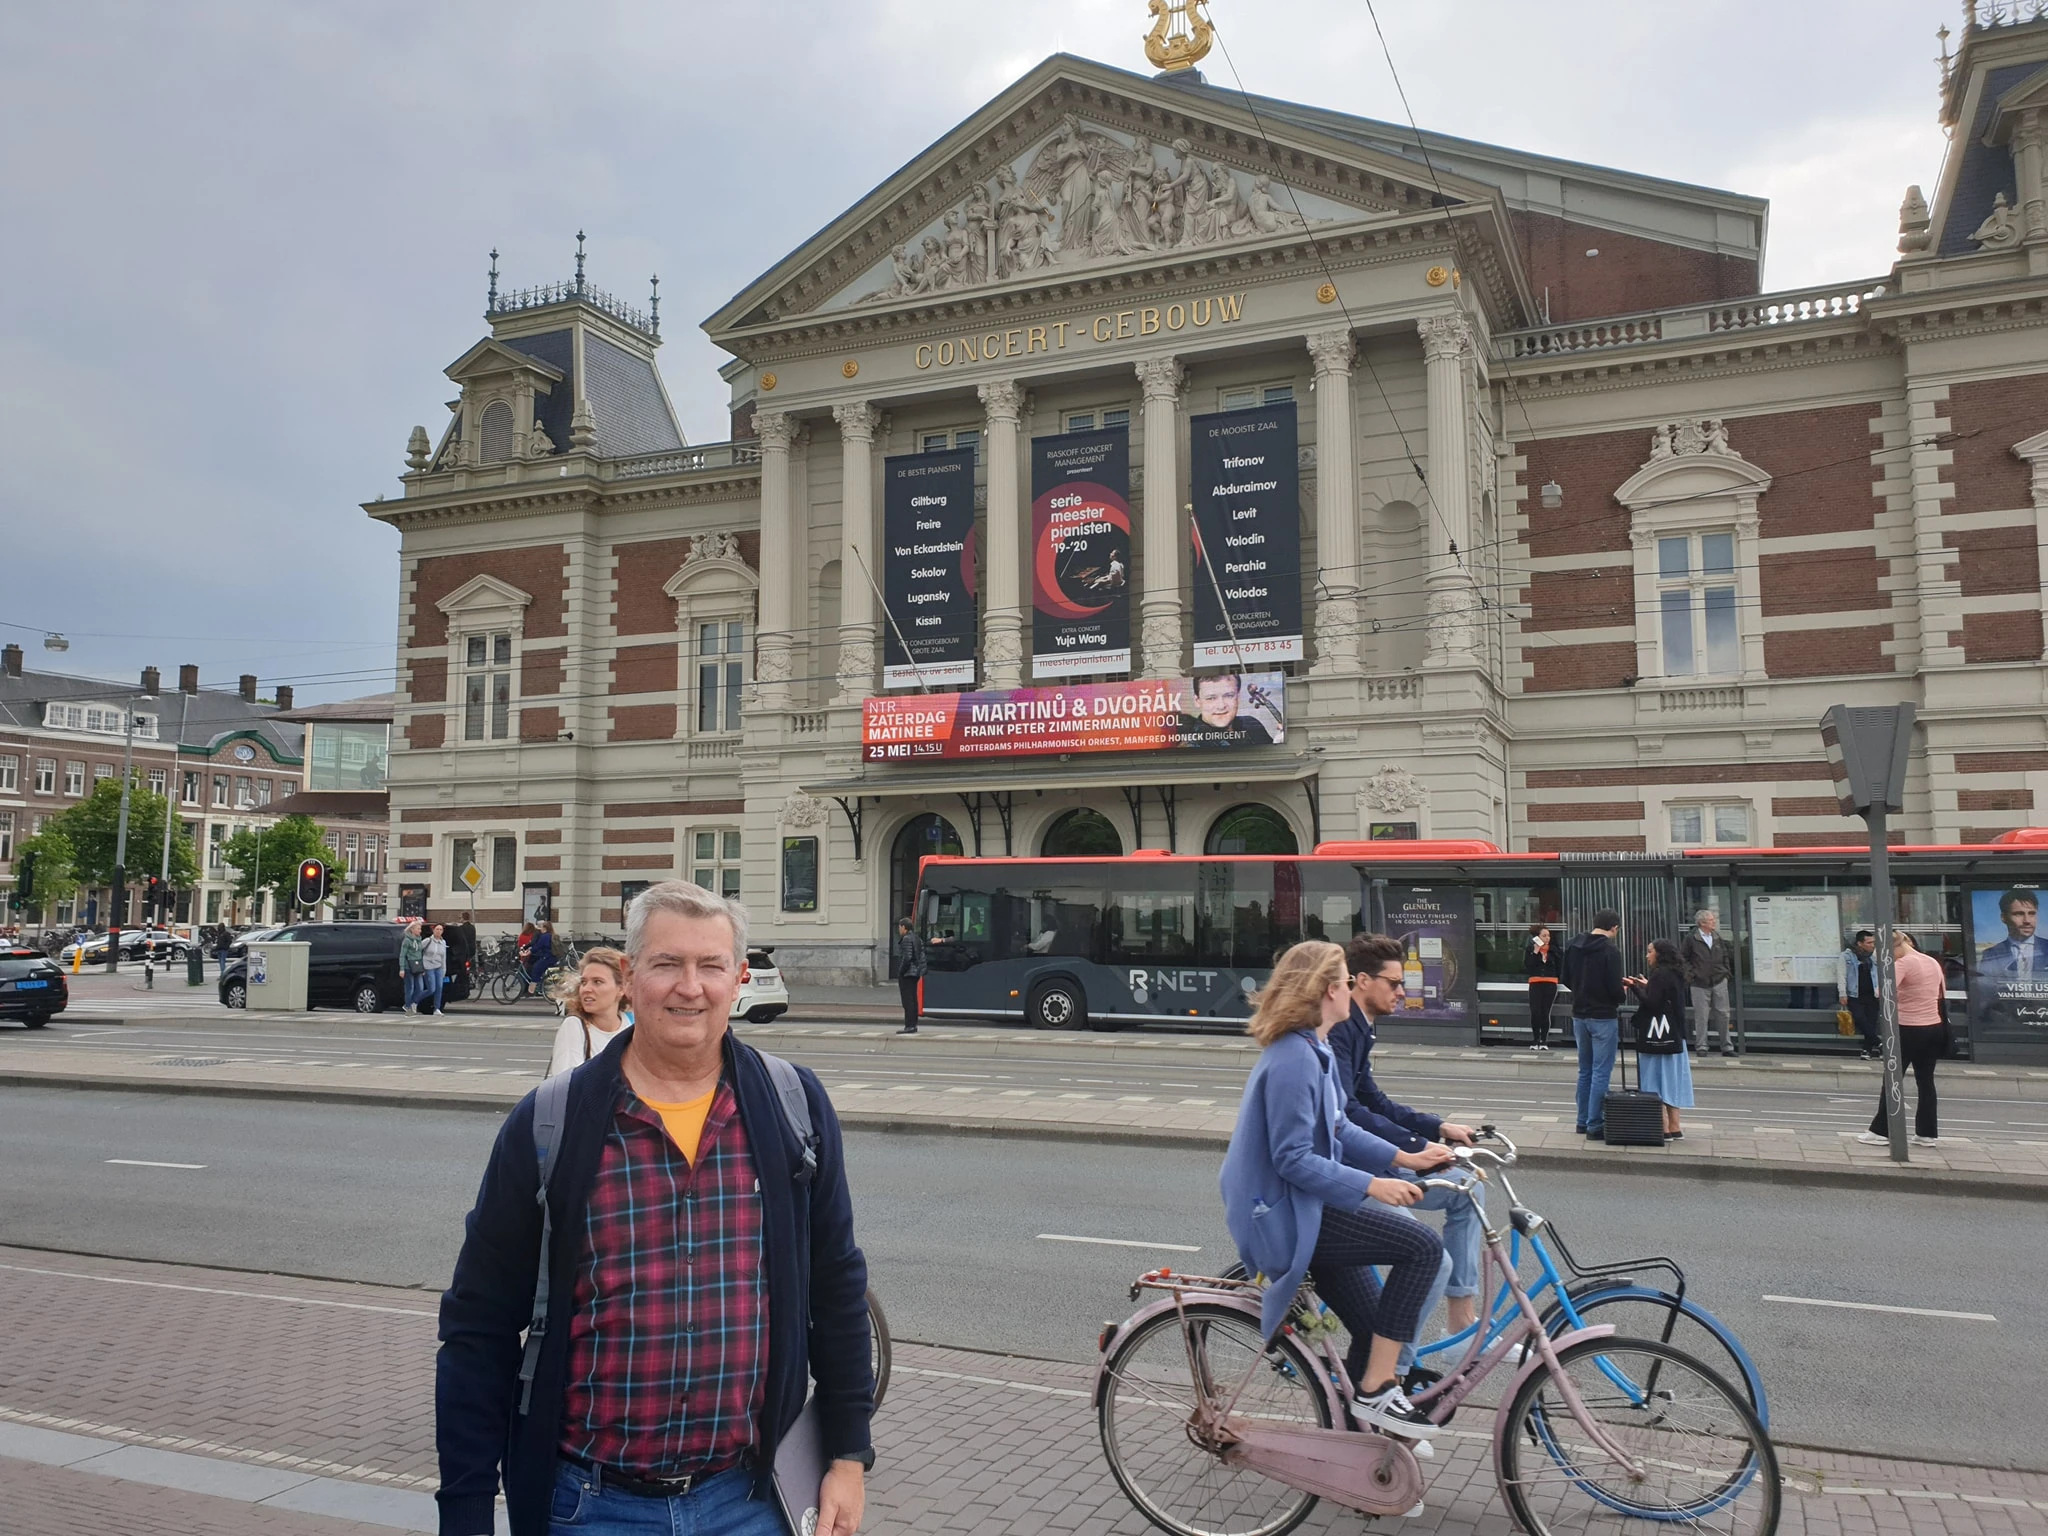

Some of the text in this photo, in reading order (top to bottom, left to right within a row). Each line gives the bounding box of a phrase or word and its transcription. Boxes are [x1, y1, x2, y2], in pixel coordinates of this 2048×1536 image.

[915, 292, 1247, 369] CONCERT-GEBOUW
[1209, 421, 1278, 437] DE MOOISTE ZAAL
[1080, 443, 1113, 455] CONCERT
[1055, 454, 1105, 467] MANAGEMENT
[1223, 456, 1265, 469] Trifonov
[897, 464, 961, 478] DE BESTE PIANISTEN
[1212, 481, 1277, 497] Abduraimov
[911, 496, 947, 507] Giltburg
[1050, 494, 1082, 509] serie
[1050, 506, 1105, 523] meester
[1232, 508, 1257, 520] Levit
[916, 520, 942, 531] Freire
[1050, 521, 1112, 541] pianisten
[1225, 534, 1265, 547] Volodin
[895, 541, 964, 557] Von Eckardstein
[911, 567, 947, 579] Sokolov
[1225, 560, 1266, 573] Perahia
[907, 590, 951, 604] Lugansky
[1225, 586, 1268, 600] Volodos
[915, 615, 942, 627] Kissin
[1232, 611, 1271, 621] CONCERTEN
[1215, 619, 1280, 631] OP ONDAGAVOND
[909, 637, 960, 646] CONCERTGEBOUW
[1055, 633, 1107, 648] Yuja Wang
[1264, 641, 1276, 651] 83
[1280, 640, 1292, 650] 45
[869, 701, 896, 713] NTR
[972, 687, 1182, 723] MARTINŮ & DVOŘÁK
[869, 711, 946, 727] ZATERDAG
[964, 714, 1184, 737] FRANK PETER ZIMMERMANN VIOOL
[869, 725, 934, 741] MATINEE
[959, 730, 1247, 752] ROTTERDAMS PHILHARMONISCH ORKEST, MANFRED HONECK DIRIGENT
[869, 746, 885, 758] 25
[887, 744, 911, 757] MEI
[1402, 902, 1441, 911] GLENLIVET
[2006, 983, 2048, 992] VISIT US
